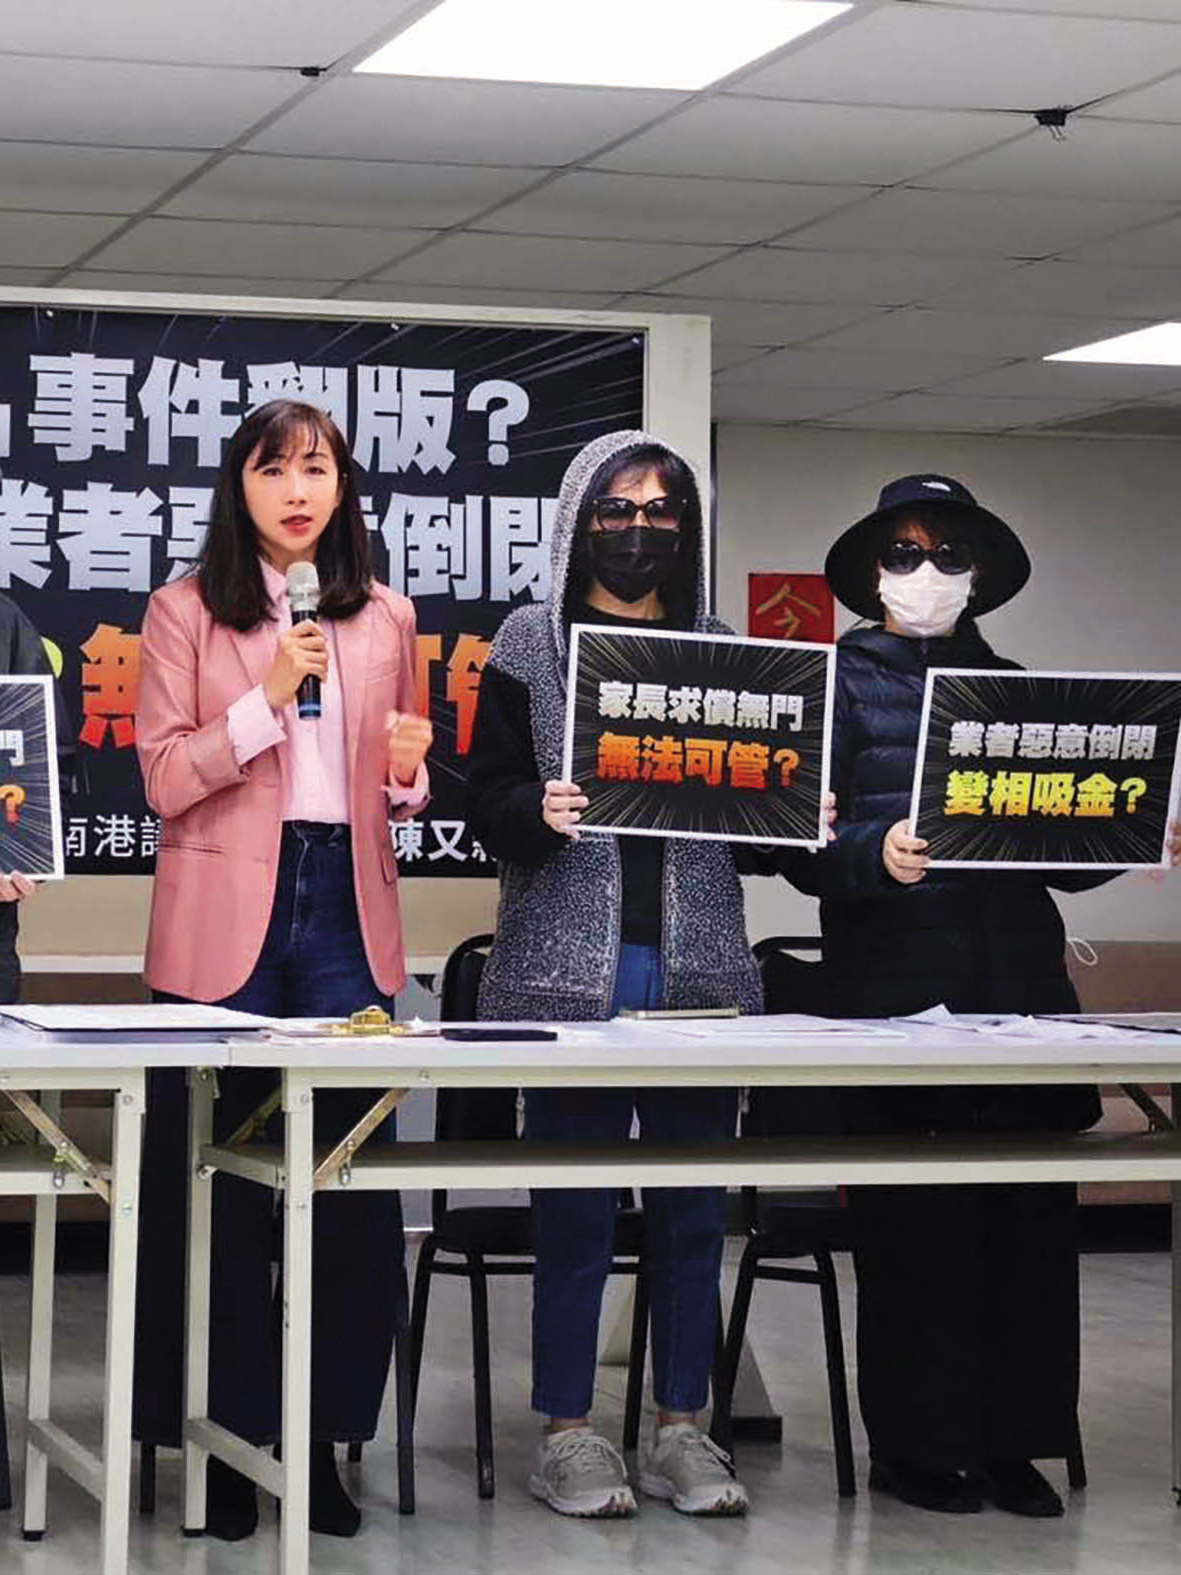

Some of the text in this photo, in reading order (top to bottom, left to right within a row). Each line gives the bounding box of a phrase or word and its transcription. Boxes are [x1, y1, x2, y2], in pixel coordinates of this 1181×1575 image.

[598, 680, 804, 732] 家長求償無門
[596, 731, 800, 788] 無法可管？
[948, 720, 1157, 760] 業者惡意倒閉
[945, 770, 1147, 817] 變相吸金？
[388, 818, 497, 861] 陳又
